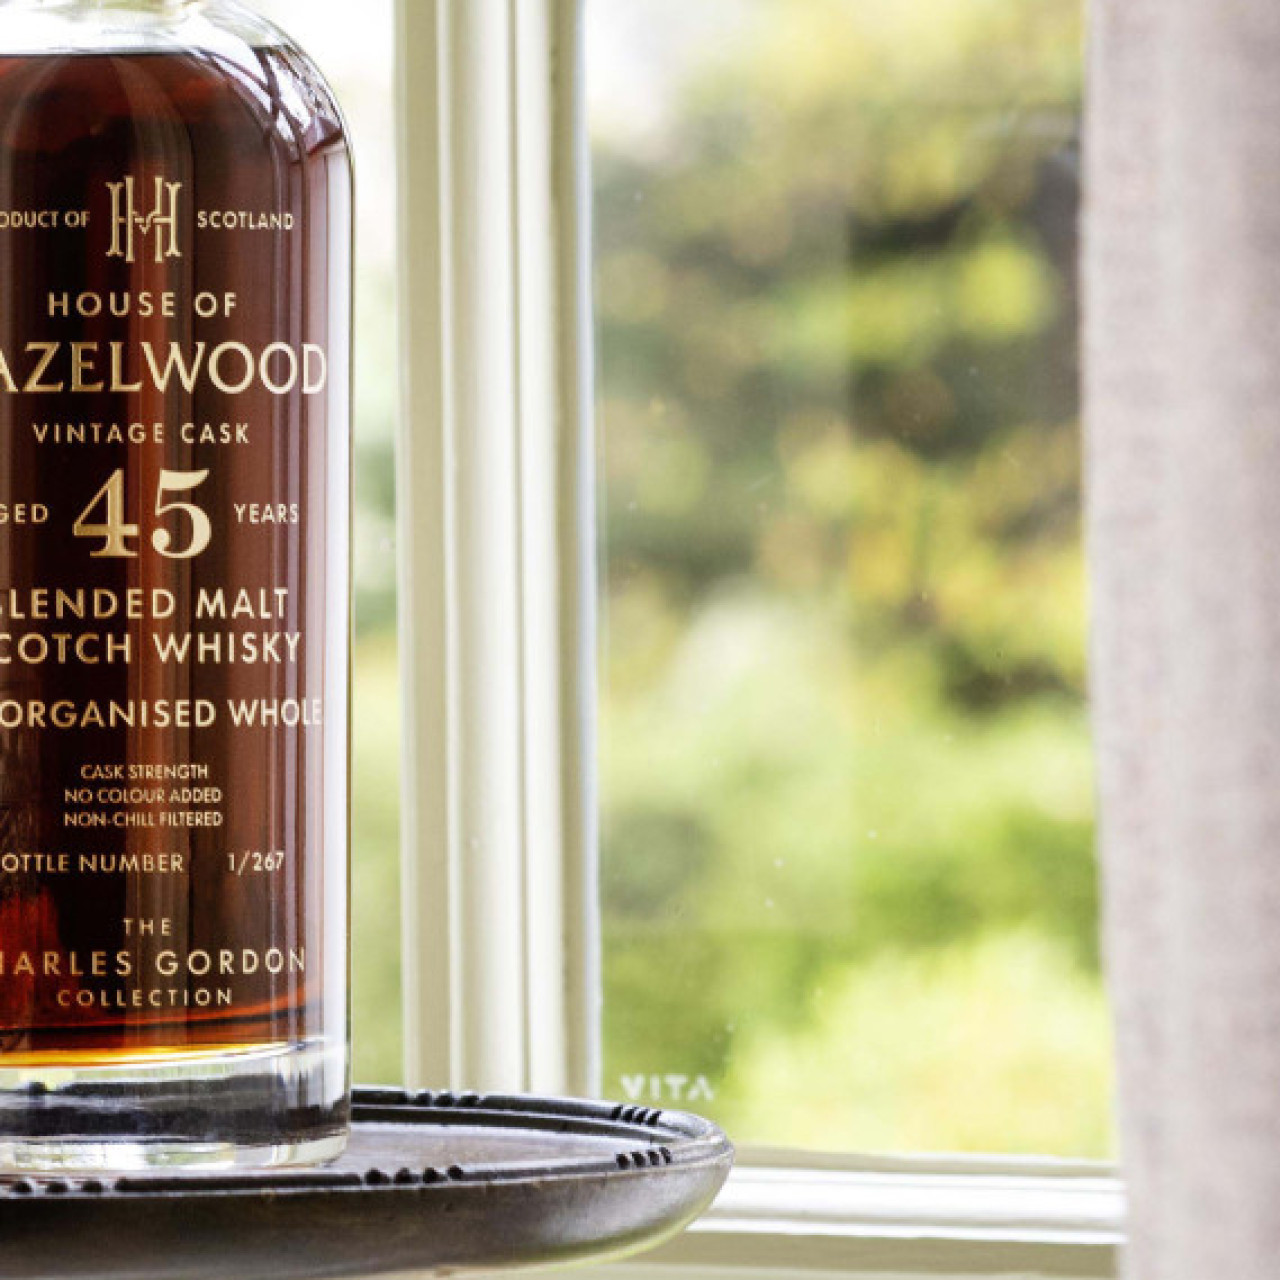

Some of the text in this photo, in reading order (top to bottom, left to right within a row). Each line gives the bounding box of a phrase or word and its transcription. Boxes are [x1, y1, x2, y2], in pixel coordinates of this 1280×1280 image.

[64, 210, 91, 228] OF
[197, 210, 295, 230] SCOTLAND
[48, 292, 238, 317] HOUSE OF
[32, 423, 250, 444] VINTAGE CASK
[73, 468, 212, 559] 45
[233, 503, 299, 524] YEARS
[195, 587, 289, 619] MALT
[152, 632, 303, 664] WHISKY
[227, 698, 323, 727] WHOLE
[80, 764, 209, 780] CASK STRENGTH
[64, 787, 223, 804] NO COLOUR ADDED
[64, 811, 224, 827] NON-CHILL FILTERED
[78, 853, 184, 872] NUMBER
[227, 850, 286, 876] 1/267
[122, 918, 172, 936] THE
[155, 947, 306, 976] GORDON
[56, 988, 234, 1007] COLLECTION
[621, 1074, 715, 1101] VITA
